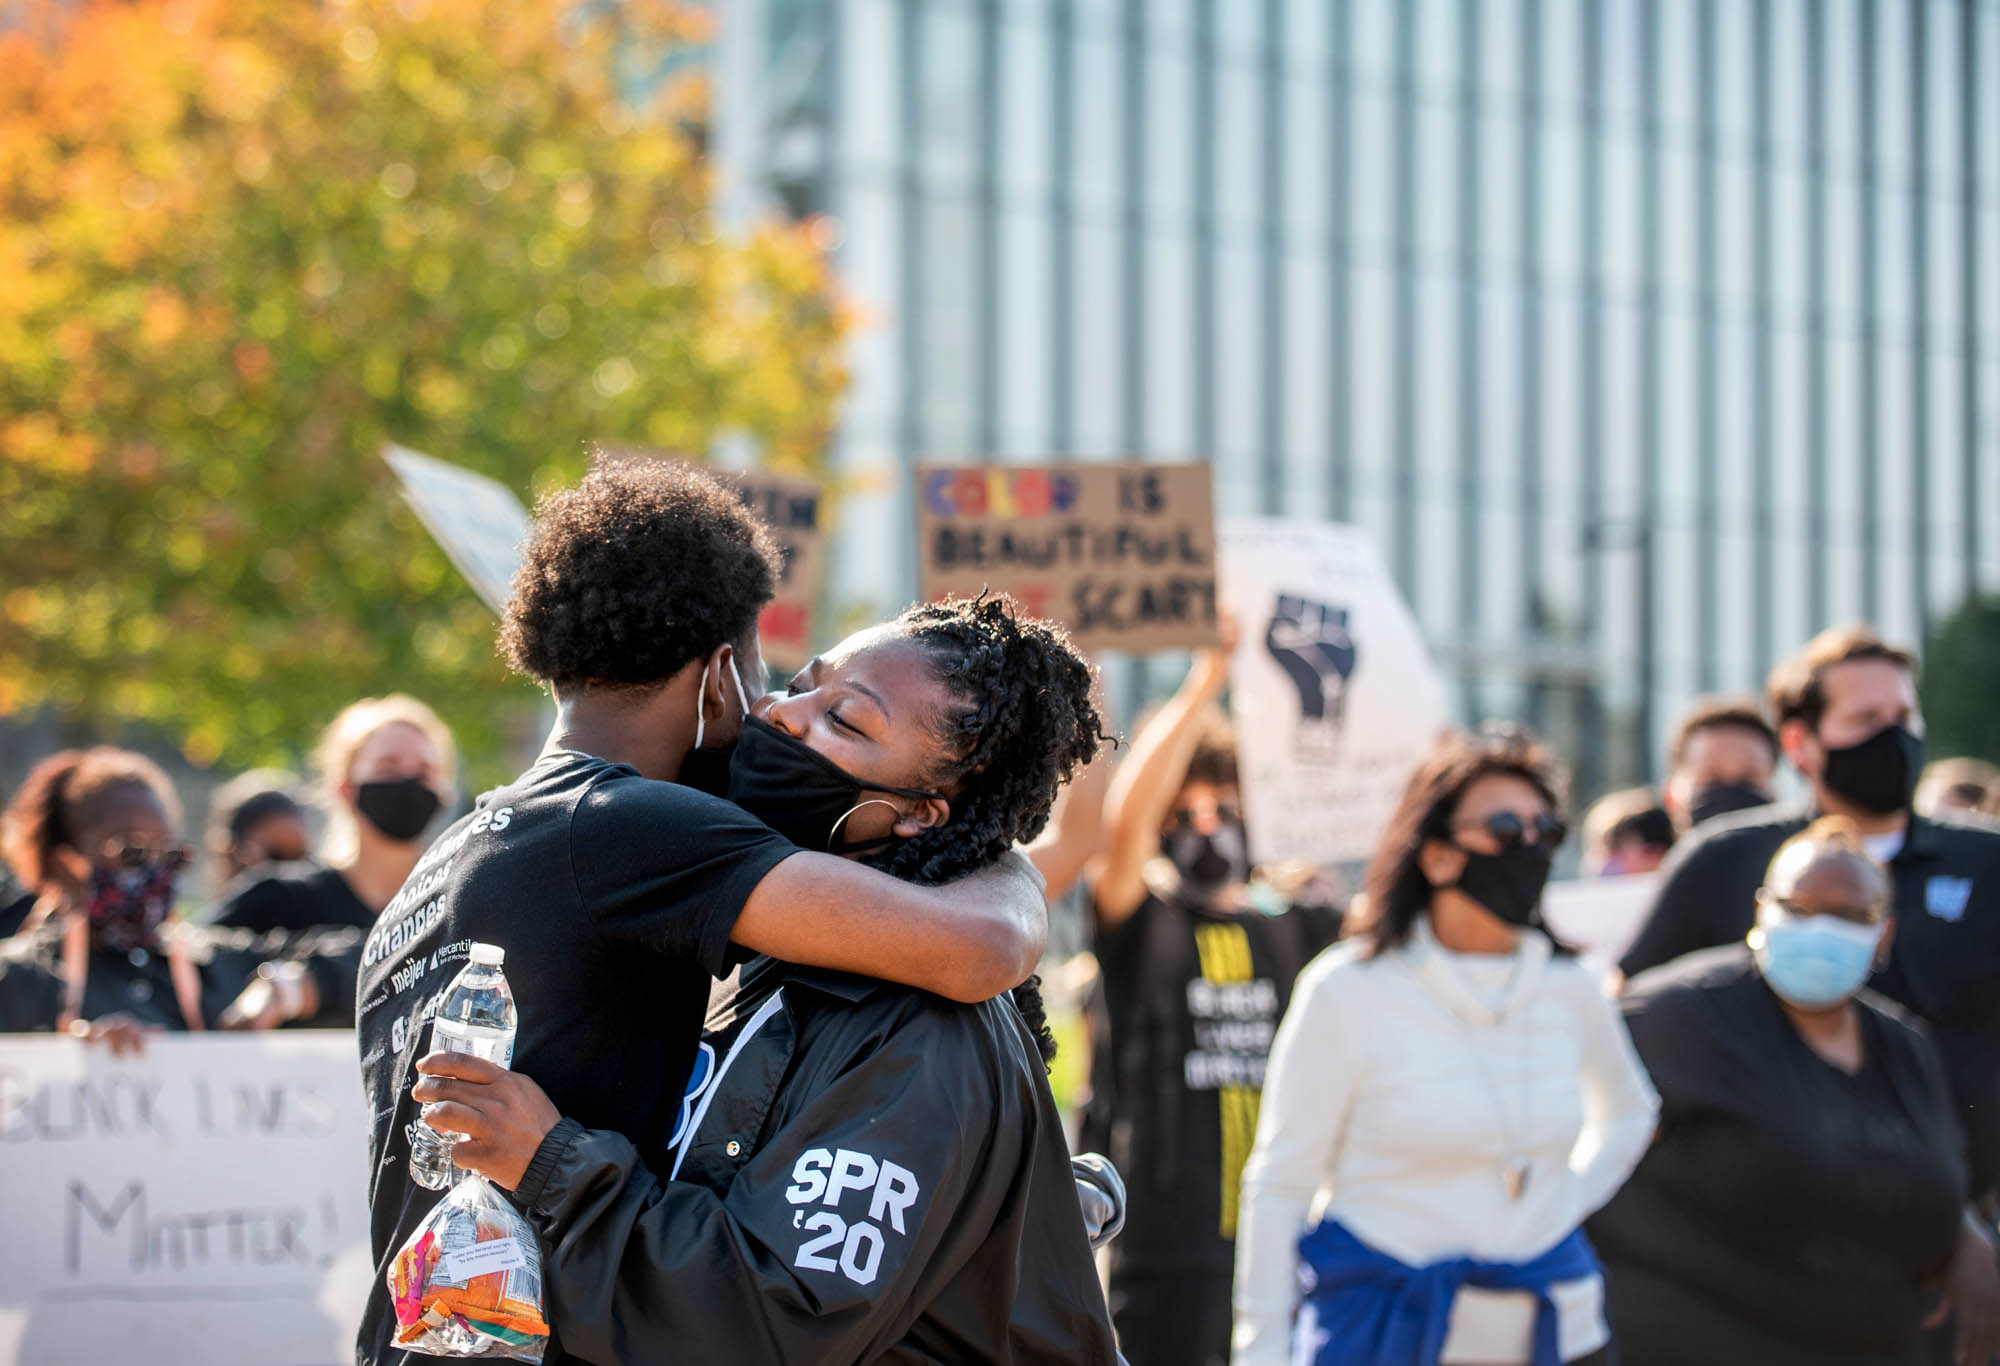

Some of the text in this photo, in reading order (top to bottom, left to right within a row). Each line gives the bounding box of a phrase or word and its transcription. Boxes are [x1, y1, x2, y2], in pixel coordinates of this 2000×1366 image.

[924, 467, 1167, 519] COLOR IS
[932, 523, 1208, 570] BEAUTIFUL
[364, 893, 446, 967] Changes
[438, 938, 477, 959] Mercantil
[390, 957, 427, 994] meijer
[785, 1148, 920, 1236] SPR
[63, 1179, 340, 1278] MATTER!
[792, 1210, 886, 1286] '20
